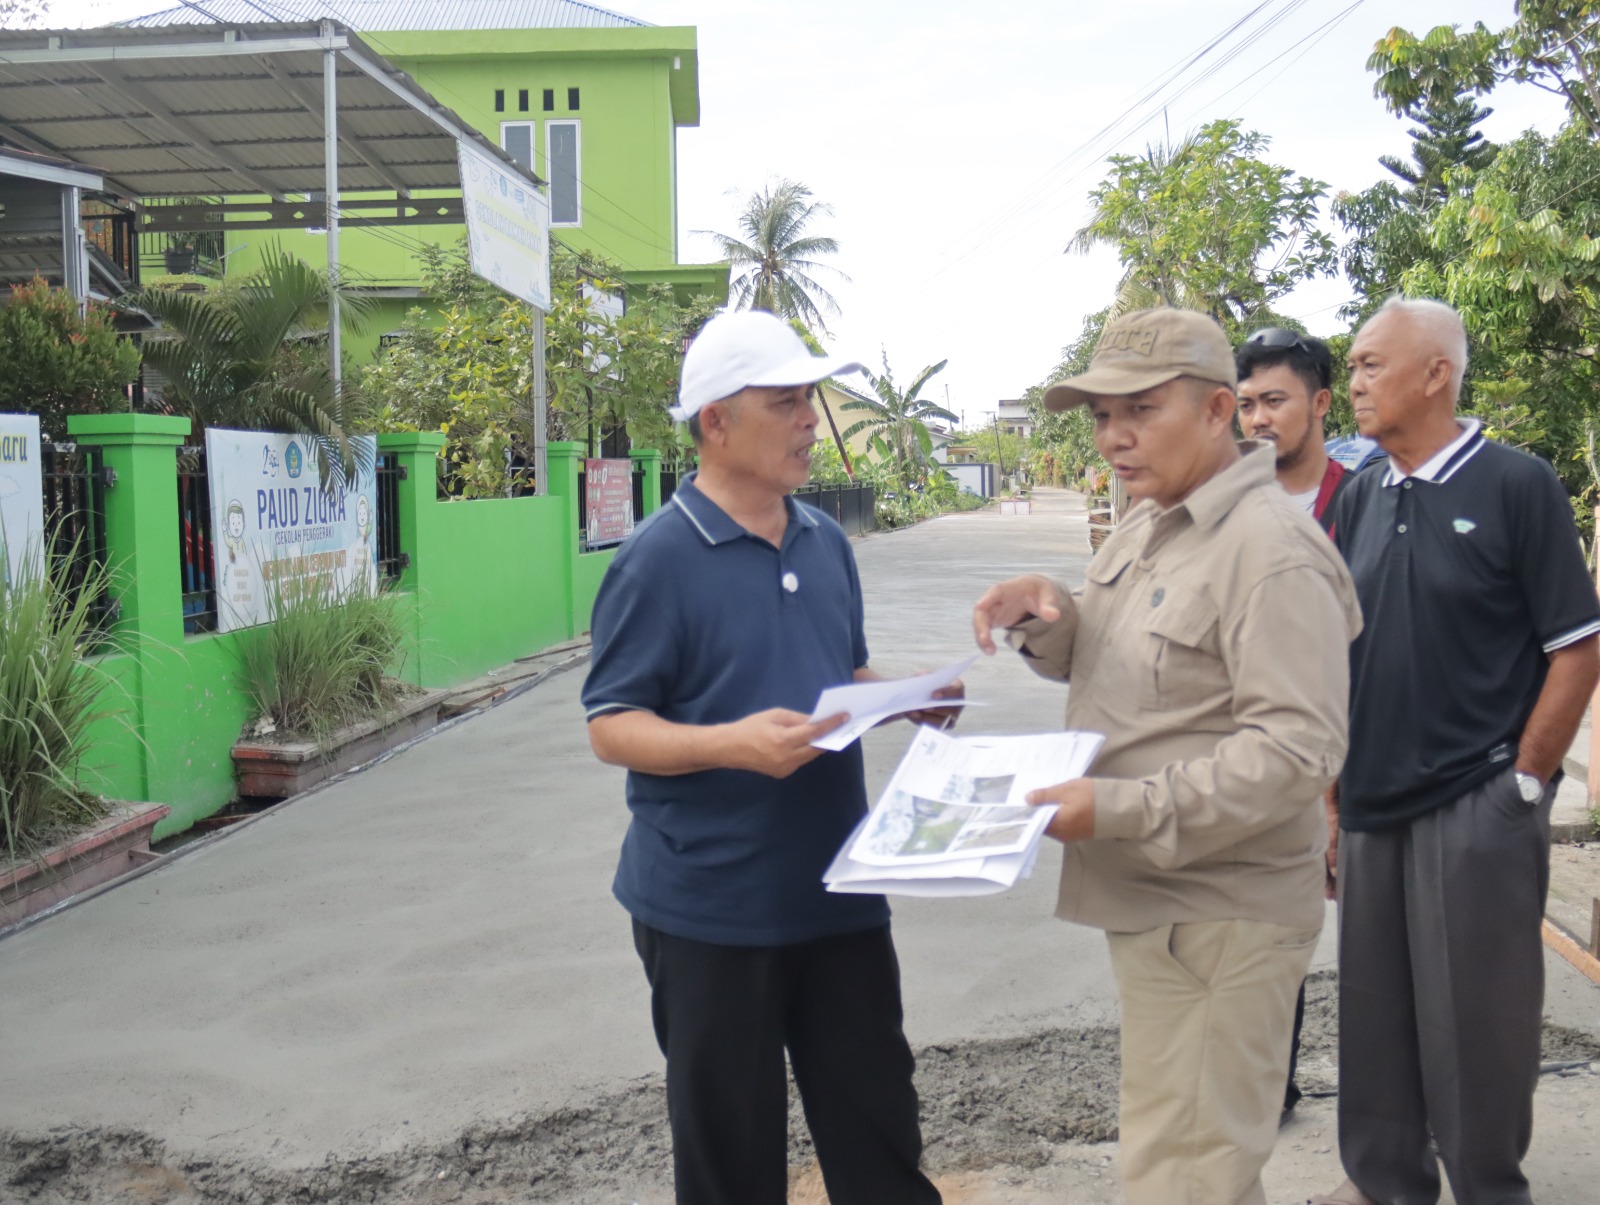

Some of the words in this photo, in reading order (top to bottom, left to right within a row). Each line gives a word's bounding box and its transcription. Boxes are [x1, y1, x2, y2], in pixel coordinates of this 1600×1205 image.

[0, 436, 27, 462] aru
[257, 488, 298, 530] PAUD
[304, 486, 346, 524] ZIQRA
